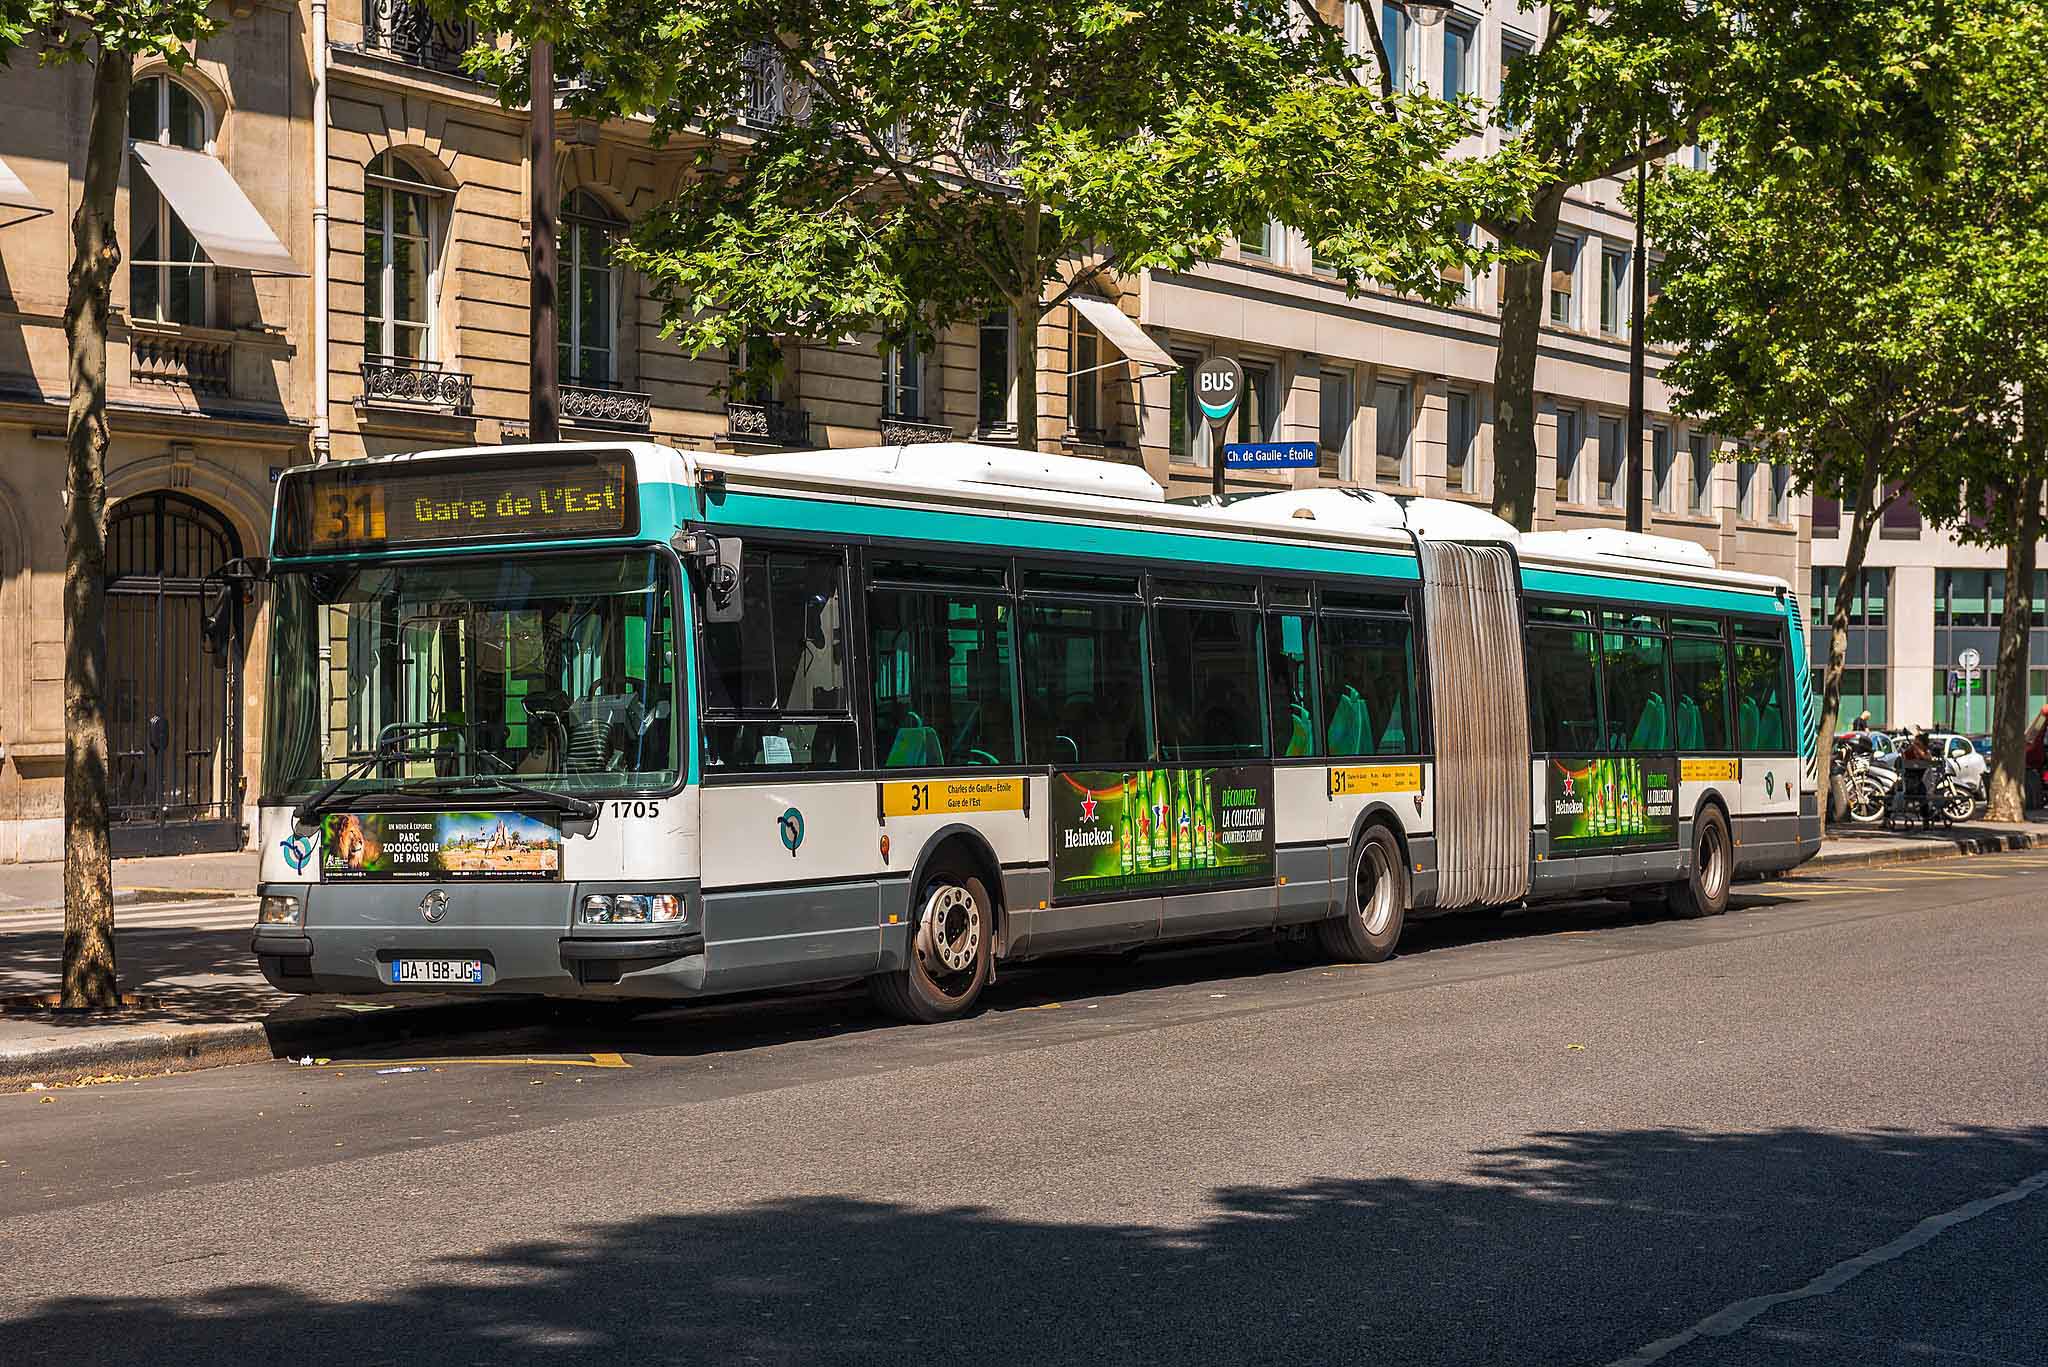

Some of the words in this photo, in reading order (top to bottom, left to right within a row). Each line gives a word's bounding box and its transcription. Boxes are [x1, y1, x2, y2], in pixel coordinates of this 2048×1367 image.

[1201, 371, 1234, 391] BUS
[1227, 451, 1240, 461] Ch.
[1243, 450, 1253, 460] de
[1255, 449, 1281, 460] Gaulle
[1289, 447, 1313, 460] Étoile
[415, 496, 487, 522] Gare
[496, 491, 531, 517] de
[327, 493, 373, 539] 31
[1729, 762, 1736, 779] 31
[948, 784, 968, 794] Charles
[968, 784, 975, 792] de
[976, 783, 992, 792] Gaulle
[1334, 771, 1346, 792] 31
[911, 784, 929, 811] 31
[948, 798, 961, 807] Gare
[962, 798, 968, 807] de
[1222, 786, 1257, 807] DÉCOUVREZ
[610, 801, 660, 819] 1705
[1555, 798, 1584, 814] Heineken
[1222, 810, 1230, 828] LA
[1231, 808, 1266, 827] COLLECTION
[399, 832, 421, 842] PARC
[1064, 826, 1113, 848] Heineken
[383, 842, 439, 853] ZOOLOGIQUE
[393, 854, 404, 863] DE
[406, 853, 429, 863] PARIS
[401, 961, 473, 980] DA-198-JG
[473, 971, 481, 980] 75
